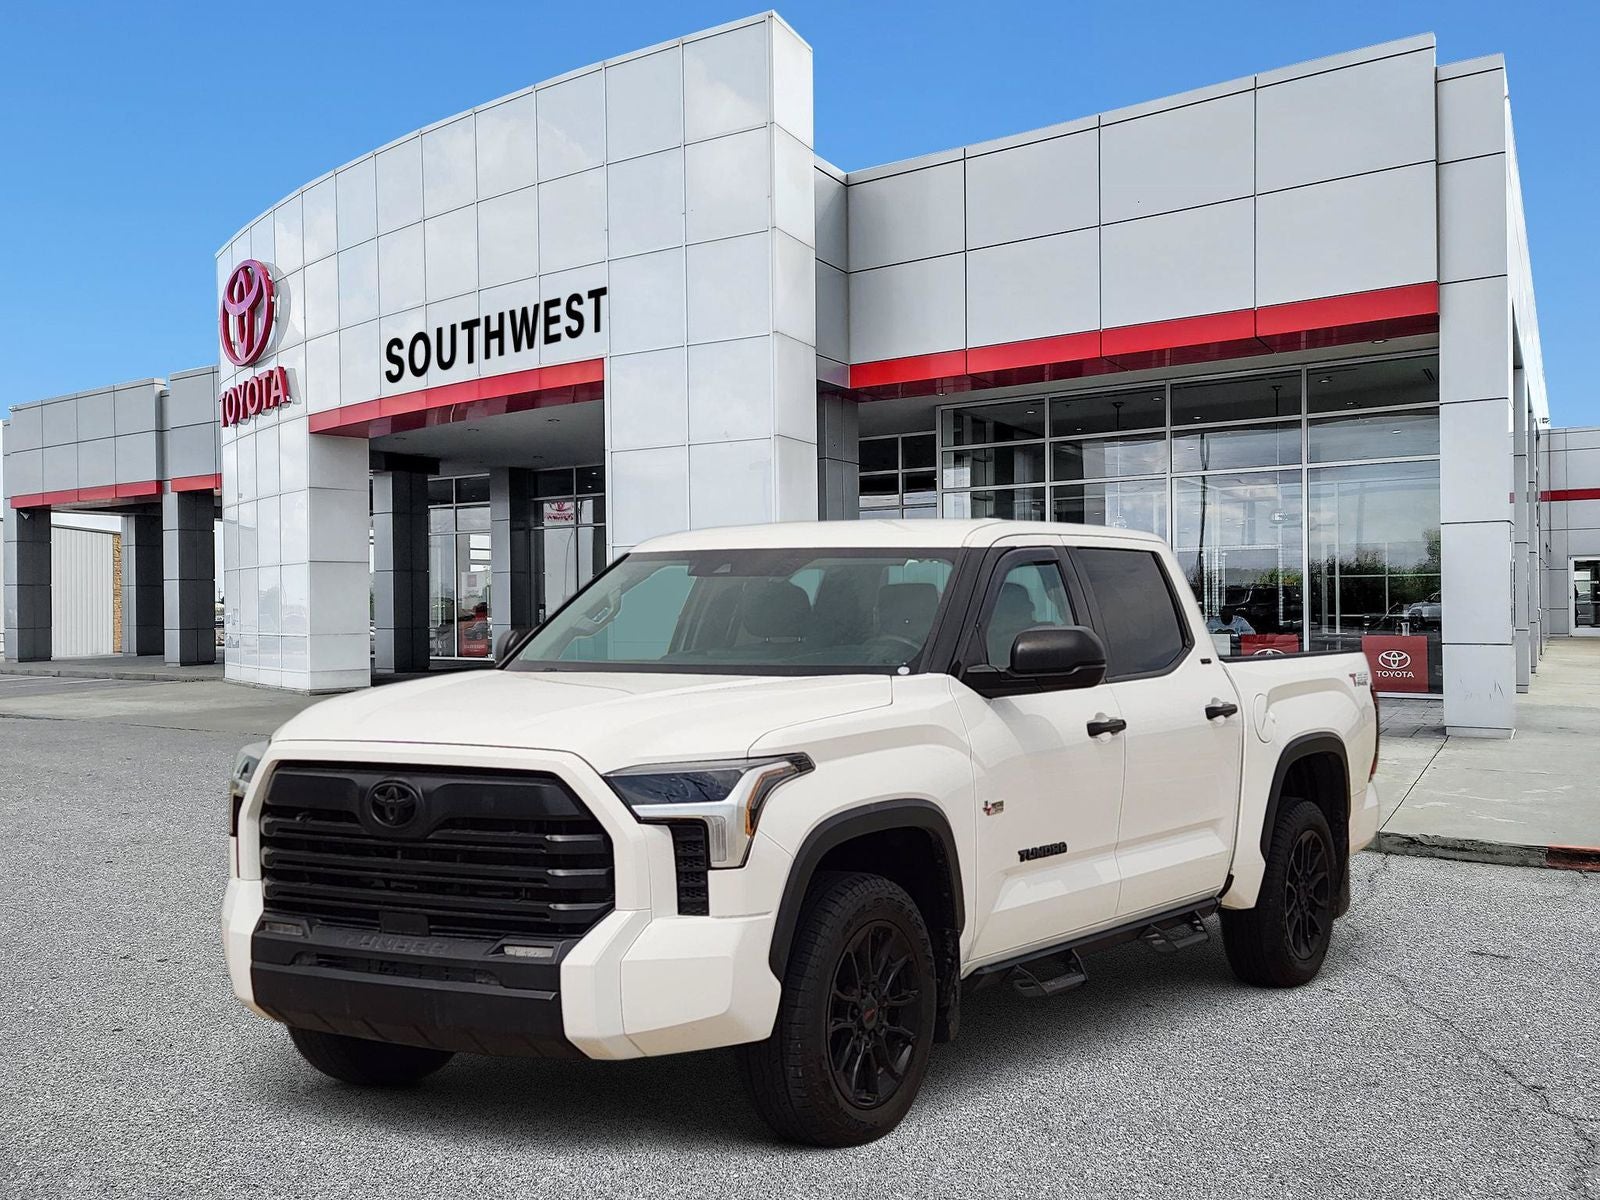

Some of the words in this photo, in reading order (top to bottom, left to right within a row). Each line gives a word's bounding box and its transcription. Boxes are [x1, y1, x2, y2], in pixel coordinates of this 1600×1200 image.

[385, 286, 608, 384] SOUTHWEST
[219, 366, 290, 428] TOYOTA
[1376, 670, 1414, 678] TOYOTA
[1017, 841, 1068, 863] TUNDRA
